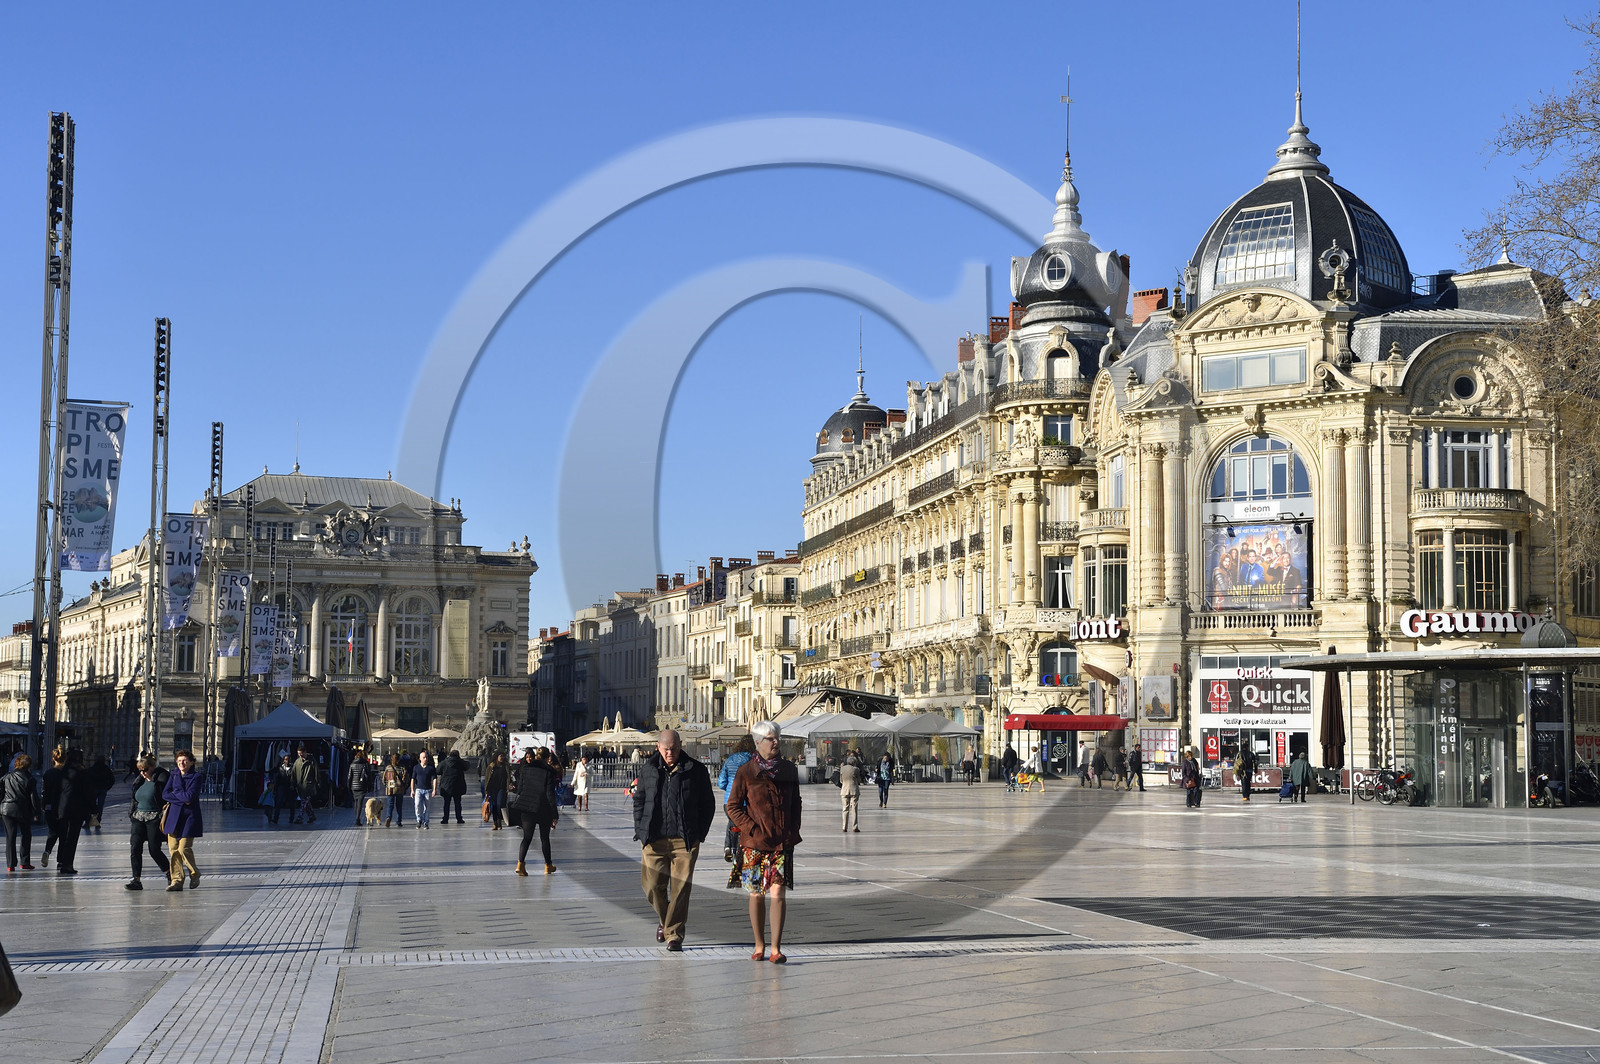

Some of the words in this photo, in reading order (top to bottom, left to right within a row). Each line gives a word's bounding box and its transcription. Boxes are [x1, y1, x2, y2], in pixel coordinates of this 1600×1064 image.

[66, 409, 124, 433] TRO
[66, 433, 91, 455] PI
[63, 457, 119, 481] SME
[62, 490, 76, 501] 25
[1244, 504, 1270, 512] eleom
[62, 515, 72, 526] 15
[61, 527, 85, 538] MAR
[221, 575, 250, 587] TRO
[220, 587, 232, 599] PI
[218, 600, 247, 611] SME
[275, 629, 295, 638] TRO
[1237, 665, 1274, 681] Quick
[1041, 673, 1075, 686] CIC
[1241, 683, 1310, 708] Quick
